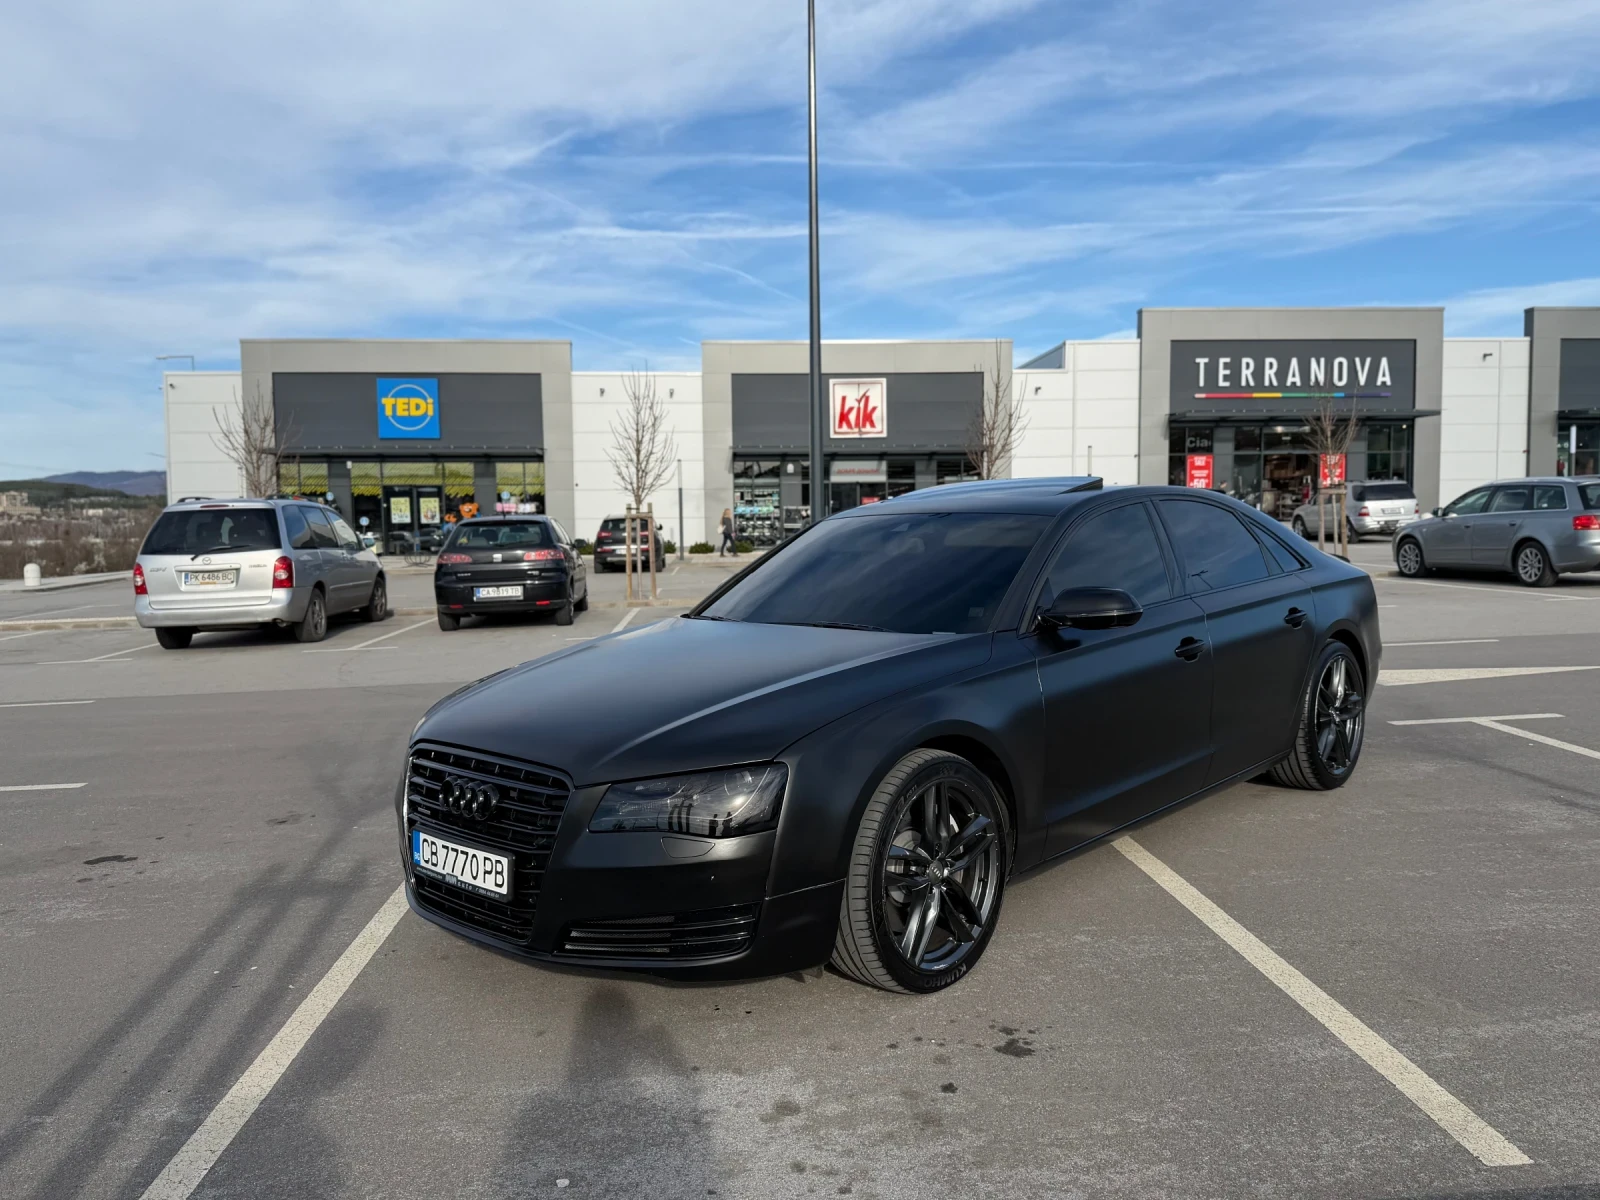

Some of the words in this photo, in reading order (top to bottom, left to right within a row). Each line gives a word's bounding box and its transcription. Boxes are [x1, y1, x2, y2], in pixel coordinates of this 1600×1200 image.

[1195, 357, 1391, 387] TERRANOVA
[381, 397, 434, 417] TEDi
[189, 572, 200, 582] PK
[201, 572, 221, 581] 6486
[222, 572, 233, 581] BC
[422, 838, 438, 867] CB
[441, 844, 479, 880] 7770
[483, 856, 505, 888] PB
